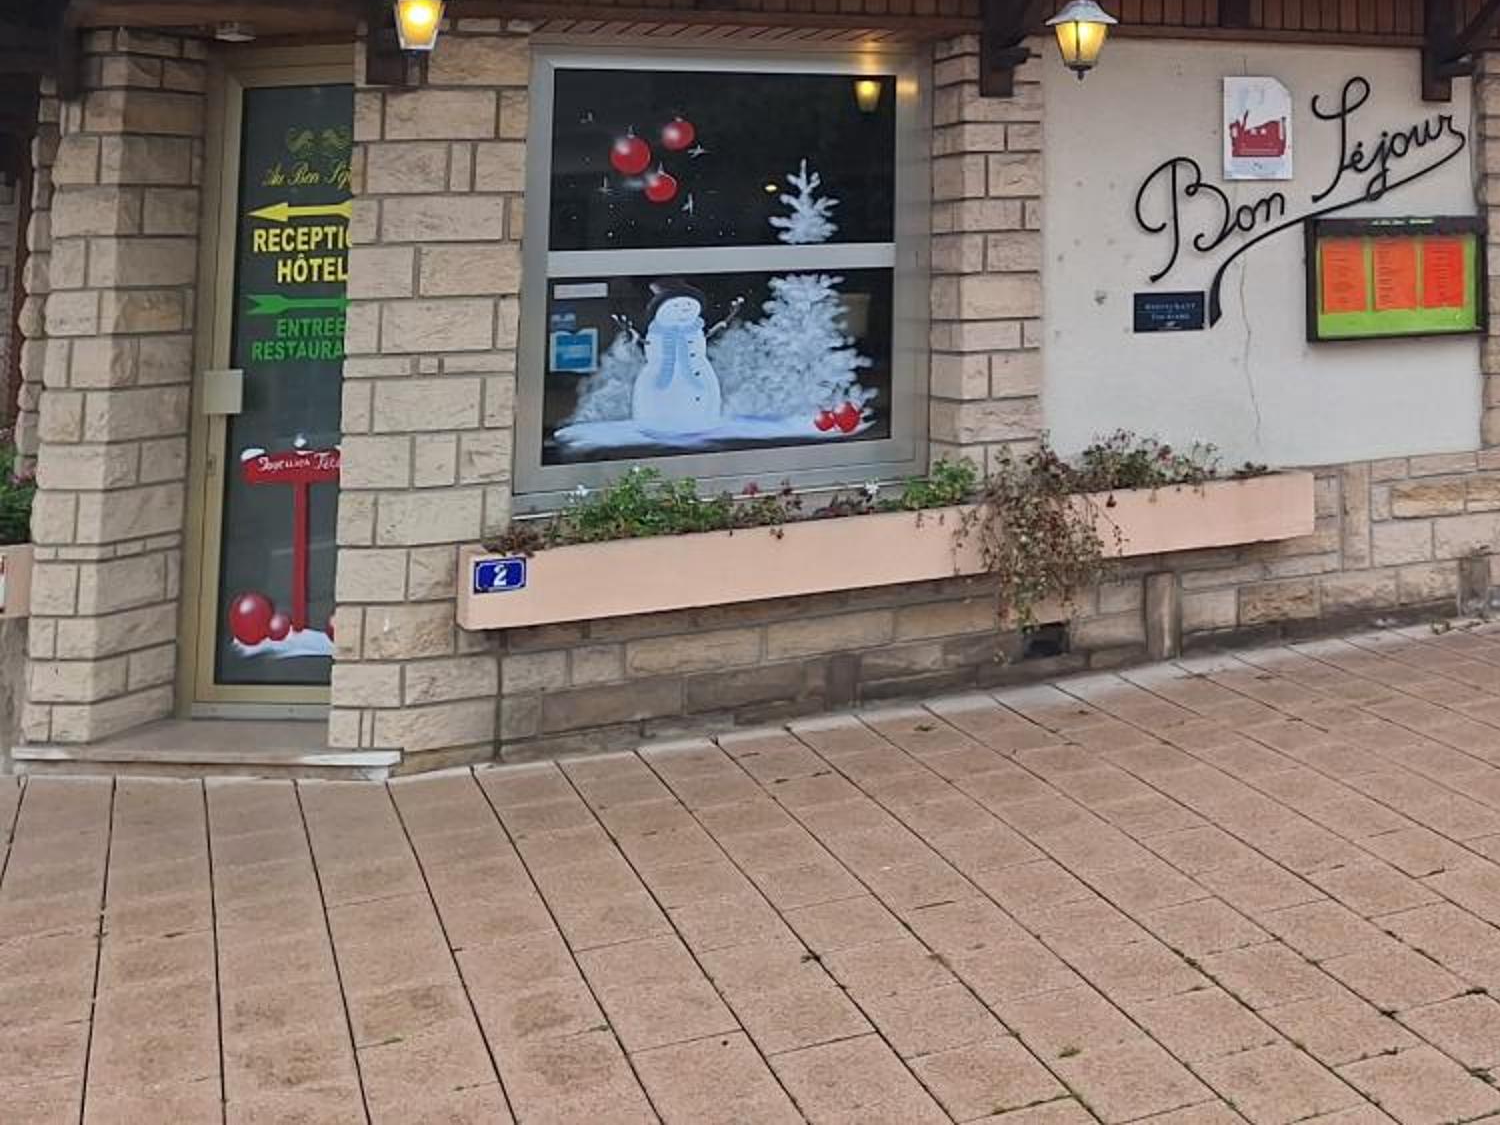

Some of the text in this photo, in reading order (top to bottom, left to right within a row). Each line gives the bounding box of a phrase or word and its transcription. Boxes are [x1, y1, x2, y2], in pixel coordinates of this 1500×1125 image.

[1135, 156, 1285, 283] Bon
[1311, 77, 1458, 203] Séjour
[277, 253, 349, 283] HÔTEL
[493, 564, 507, 586] 2
